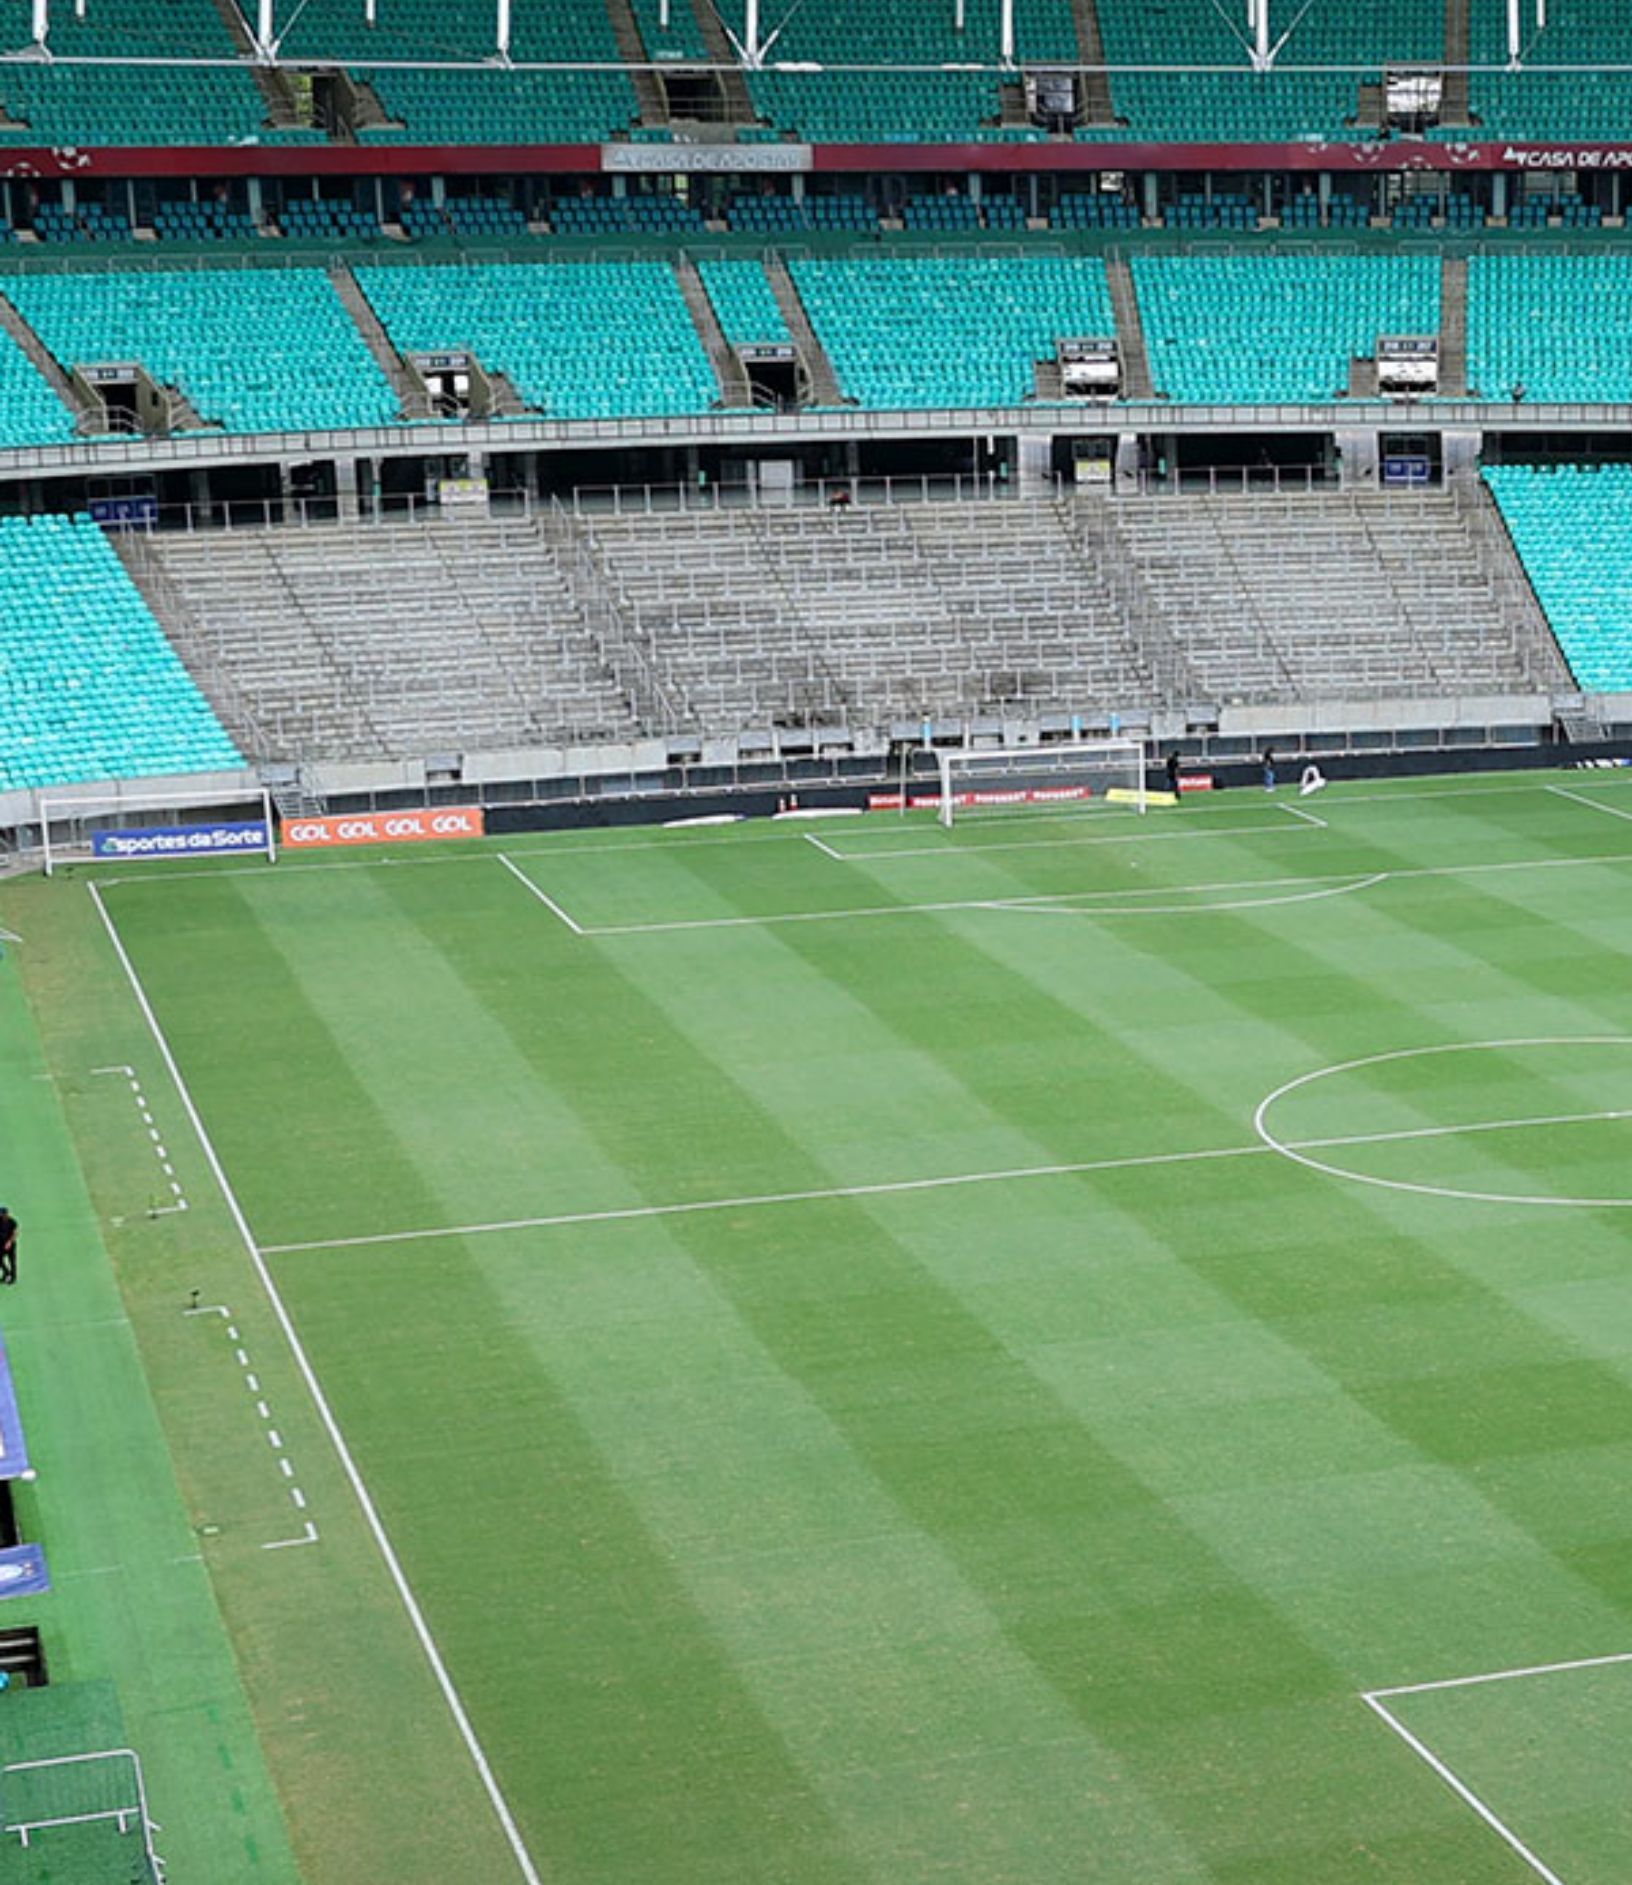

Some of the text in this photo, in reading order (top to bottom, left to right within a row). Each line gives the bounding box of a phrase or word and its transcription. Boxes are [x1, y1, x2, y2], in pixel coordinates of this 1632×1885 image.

[1528, 151, 1574, 167] CASA
[1577, 151, 1600, 167] DE
[290, 815, 472, 841] GOL GOL GOL GOL
